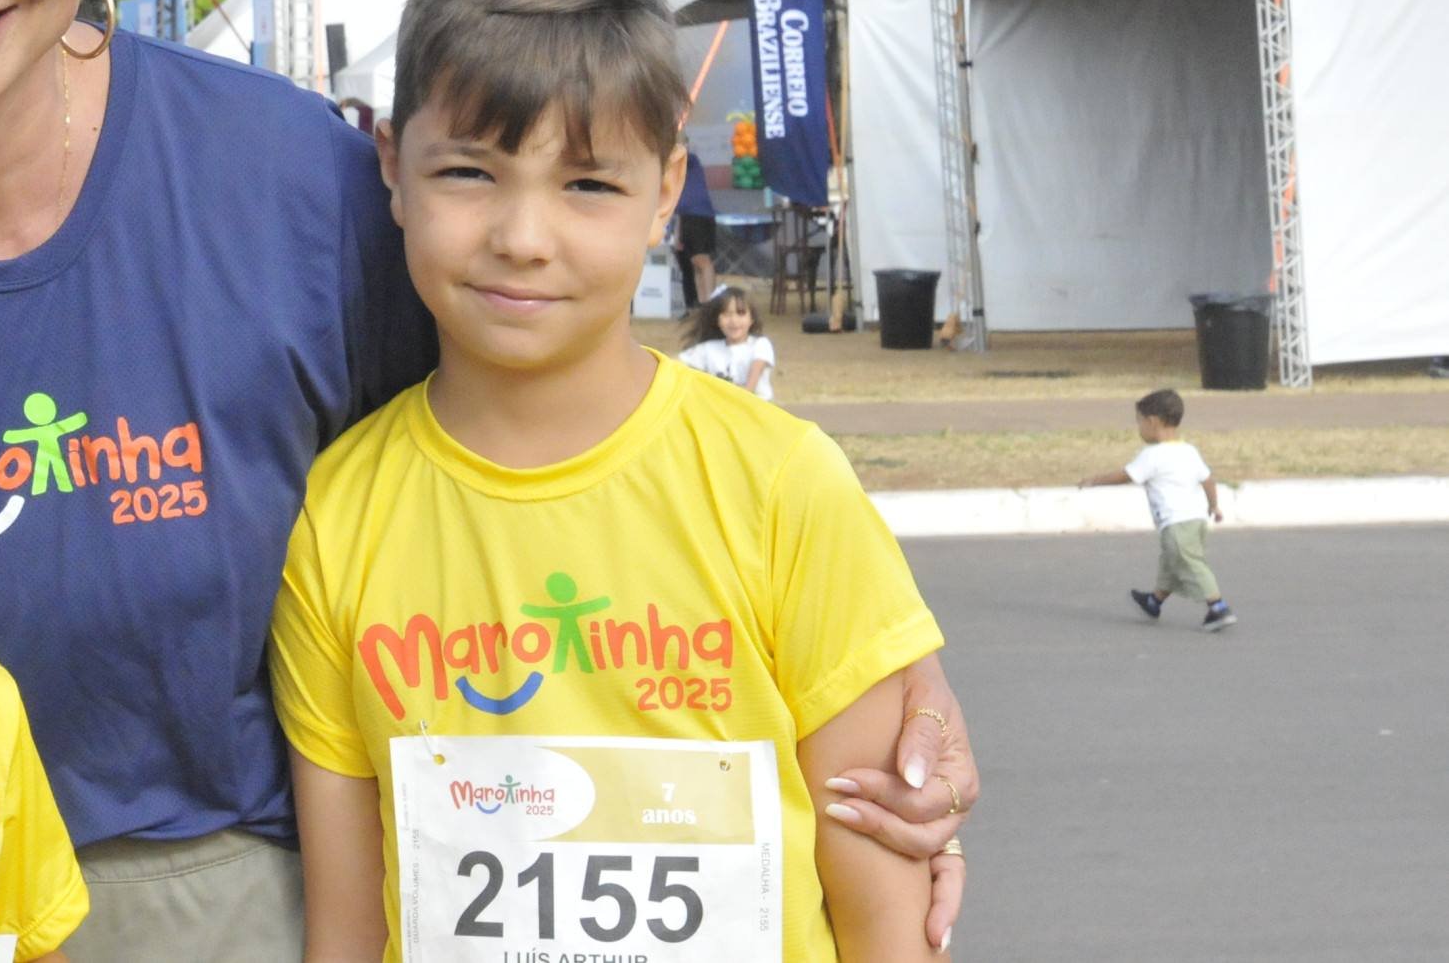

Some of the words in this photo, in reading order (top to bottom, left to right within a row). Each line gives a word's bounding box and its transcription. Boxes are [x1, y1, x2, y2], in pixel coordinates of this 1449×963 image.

[109, 480, 208, 525] 2025
[358, 572, 733, 721] Marotinha
[634, 676, 733, 712] 2025
[450, 775, 555, 809] Marotinha
[662, 782, 675, 803] 7
[526, 805, 555, 815] 2025
[642, 807, 697, 824] anos
[760, 842, 771, 895] MEDALHA
[453, 850, 704, 943] 2155
[759, 907, 770, 932] 2155
